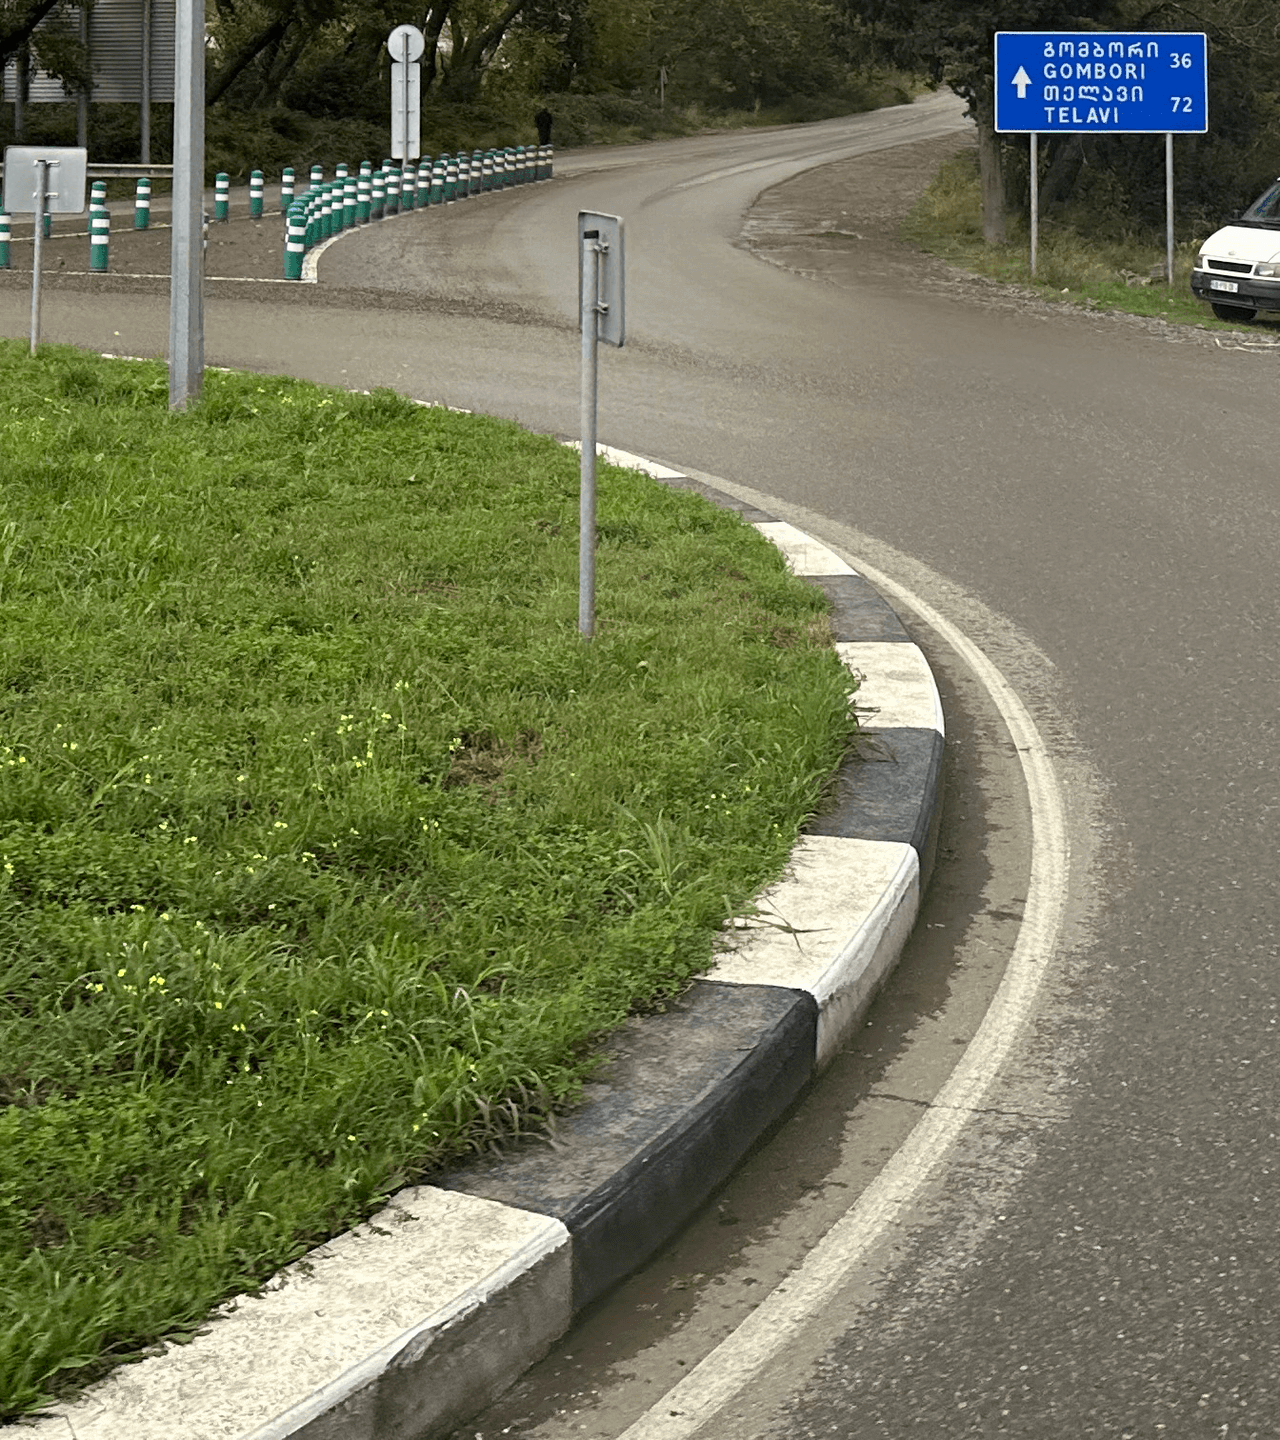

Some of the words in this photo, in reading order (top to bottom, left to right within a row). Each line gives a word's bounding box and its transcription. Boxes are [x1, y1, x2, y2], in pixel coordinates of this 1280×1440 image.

[1043, 41, 1159, 58] გომბორი
[1169, 52, 1192, 69] 36
[1043, 63, 1146, 80] GOMBORI
[1043, 85, 1144, 102] თელავი
[1170, 96, 1193, 113] 72
[1043, 107, 1119, 124] TELAVI
